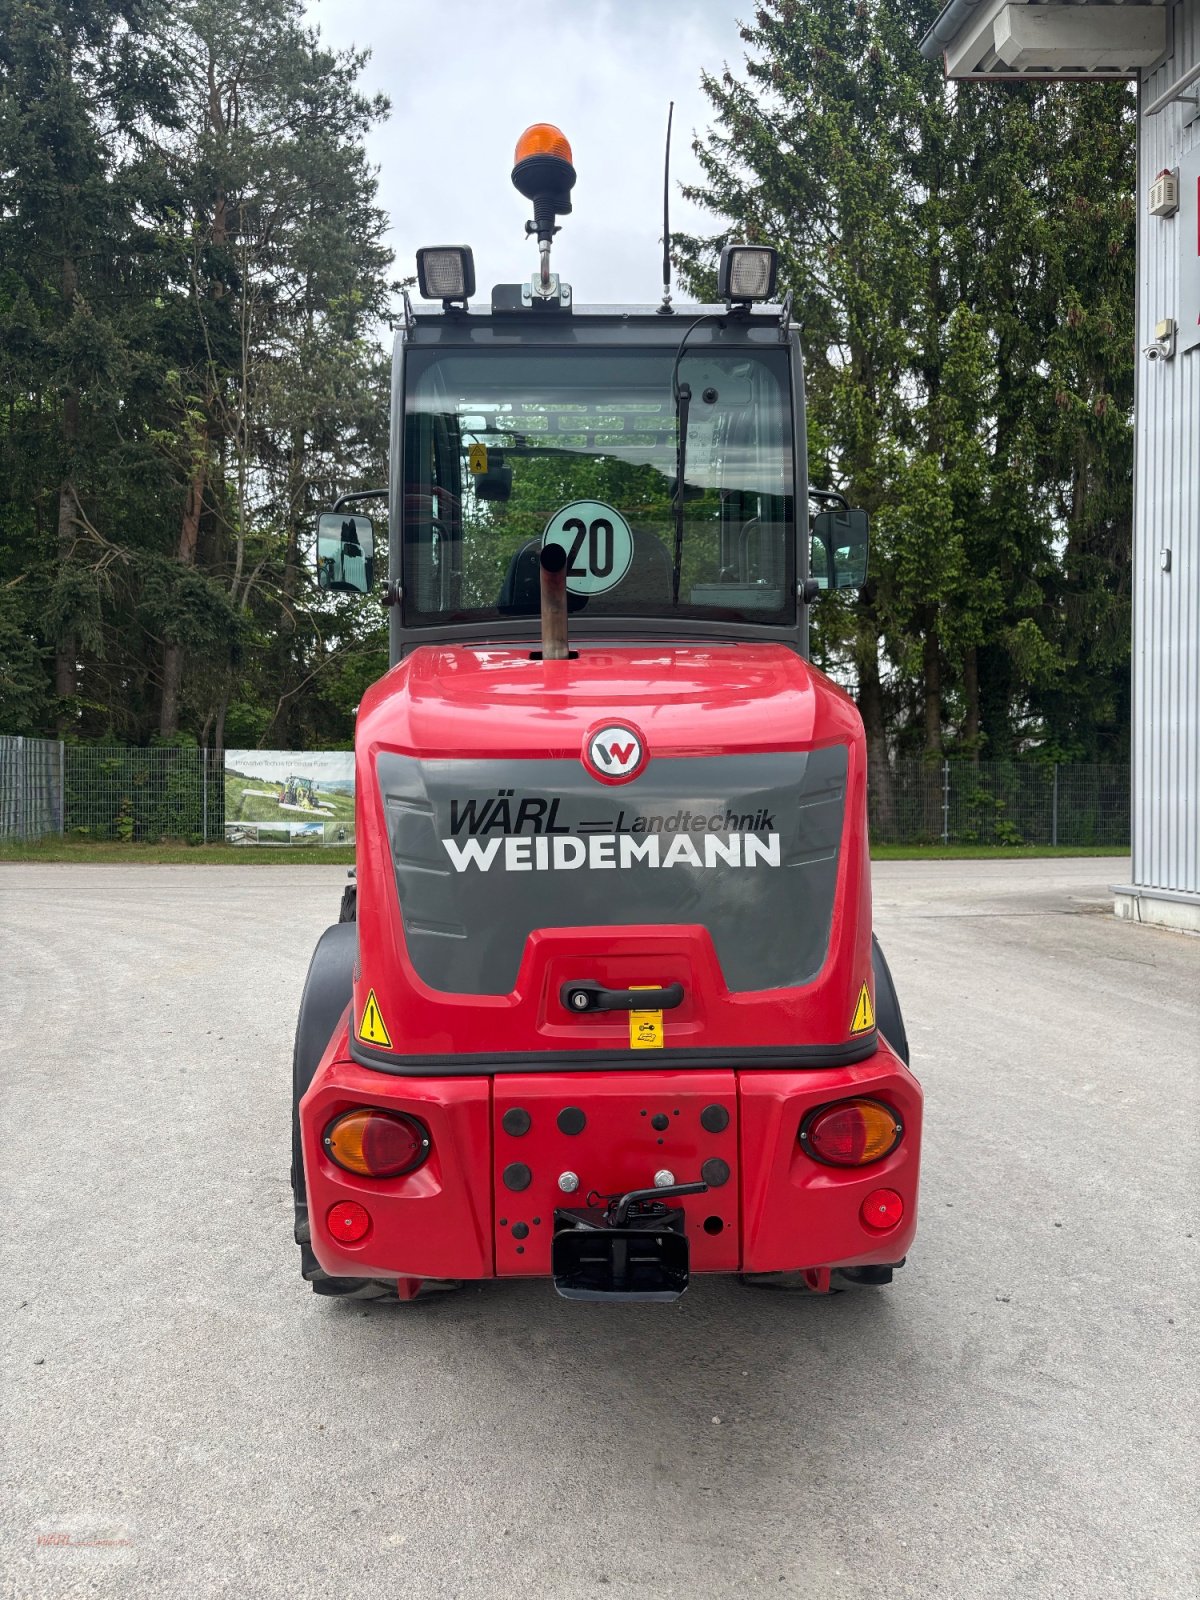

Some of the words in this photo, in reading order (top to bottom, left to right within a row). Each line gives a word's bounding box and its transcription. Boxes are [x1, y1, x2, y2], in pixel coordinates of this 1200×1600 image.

[562, 518, 614, 578] 20
[450, 789, 570, 836] WÄRL
[615, 809, 777, 833] Landtechnik
[442, 833, 781, 873] WEIDEMANN
